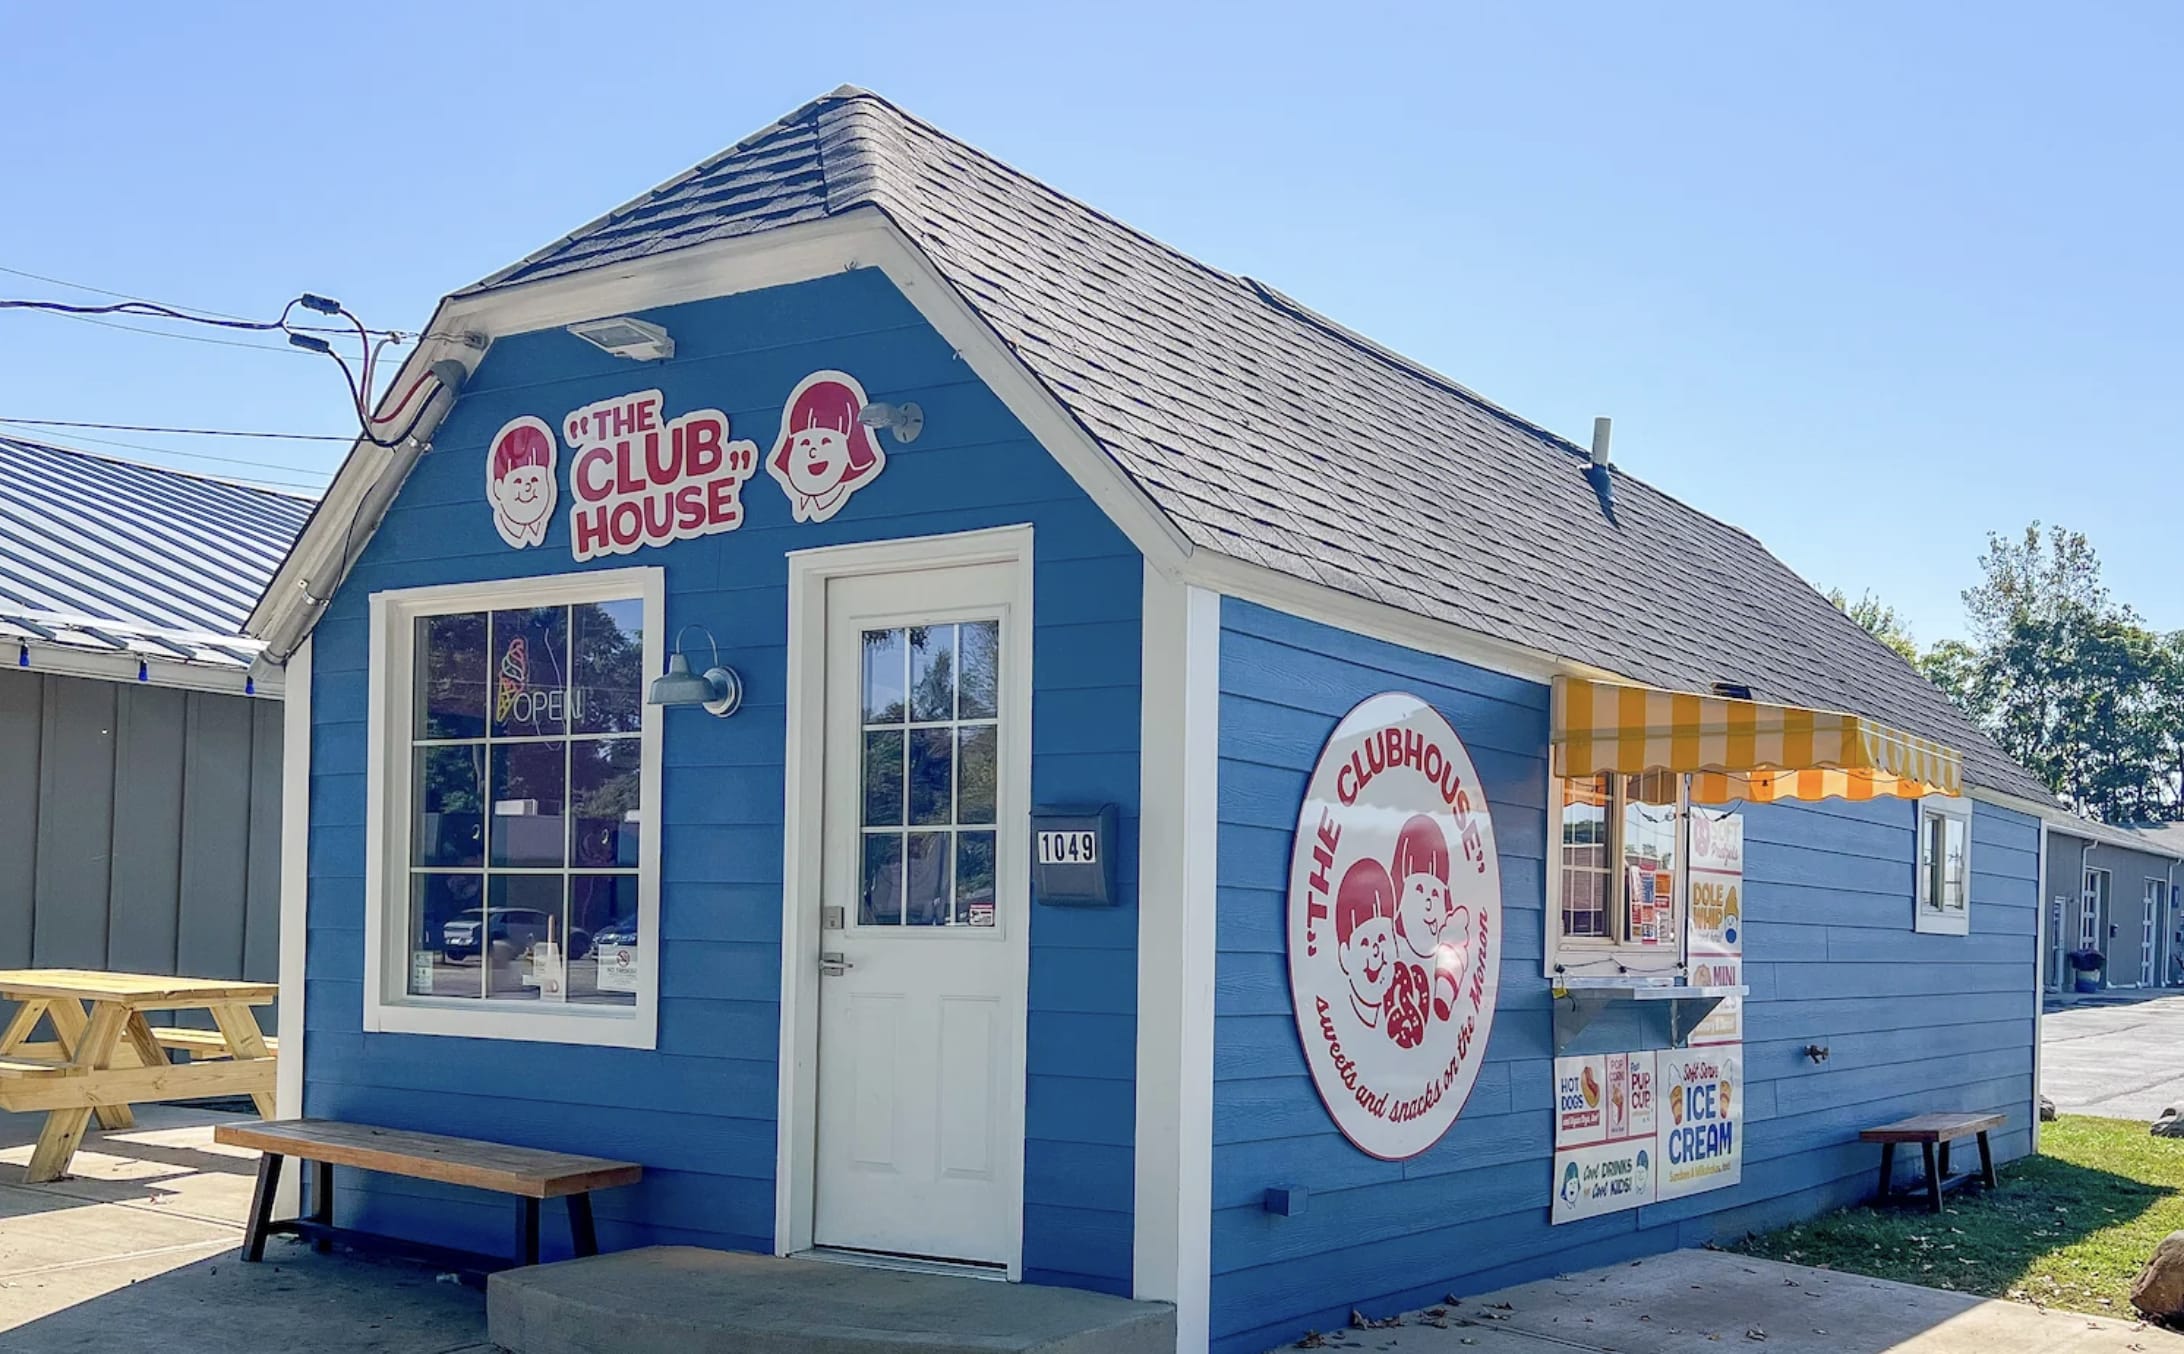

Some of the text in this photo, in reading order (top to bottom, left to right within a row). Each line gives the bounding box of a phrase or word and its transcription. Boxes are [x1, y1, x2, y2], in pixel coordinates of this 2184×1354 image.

[576, 477, 737, 554] HOUSE
[513, 690, 583, 722] OPEN
[1042, 832, 1094, 862] 1049
[1693, 881, 1723, 907] DOLE
[1693, 906, 1724, 930] WHIP
[1713, 965, 1736, 986] MINI
[1316, 906, 1489, 1124] sweets and snacks on the Monon
[1561, 1077, 1580, 1093] HOT
[1631, 1072, 1651, 1090] PUP
[1561, 1094, 1584, 1111] DOGS
[1631, 1091, 1651, 1109] CUP
[1686, 1084, 1716, 1121] ICE
[1668, 1121, 1732, 1165] CREAM
[1602, 1158, 1632, 1178] DRINKS
